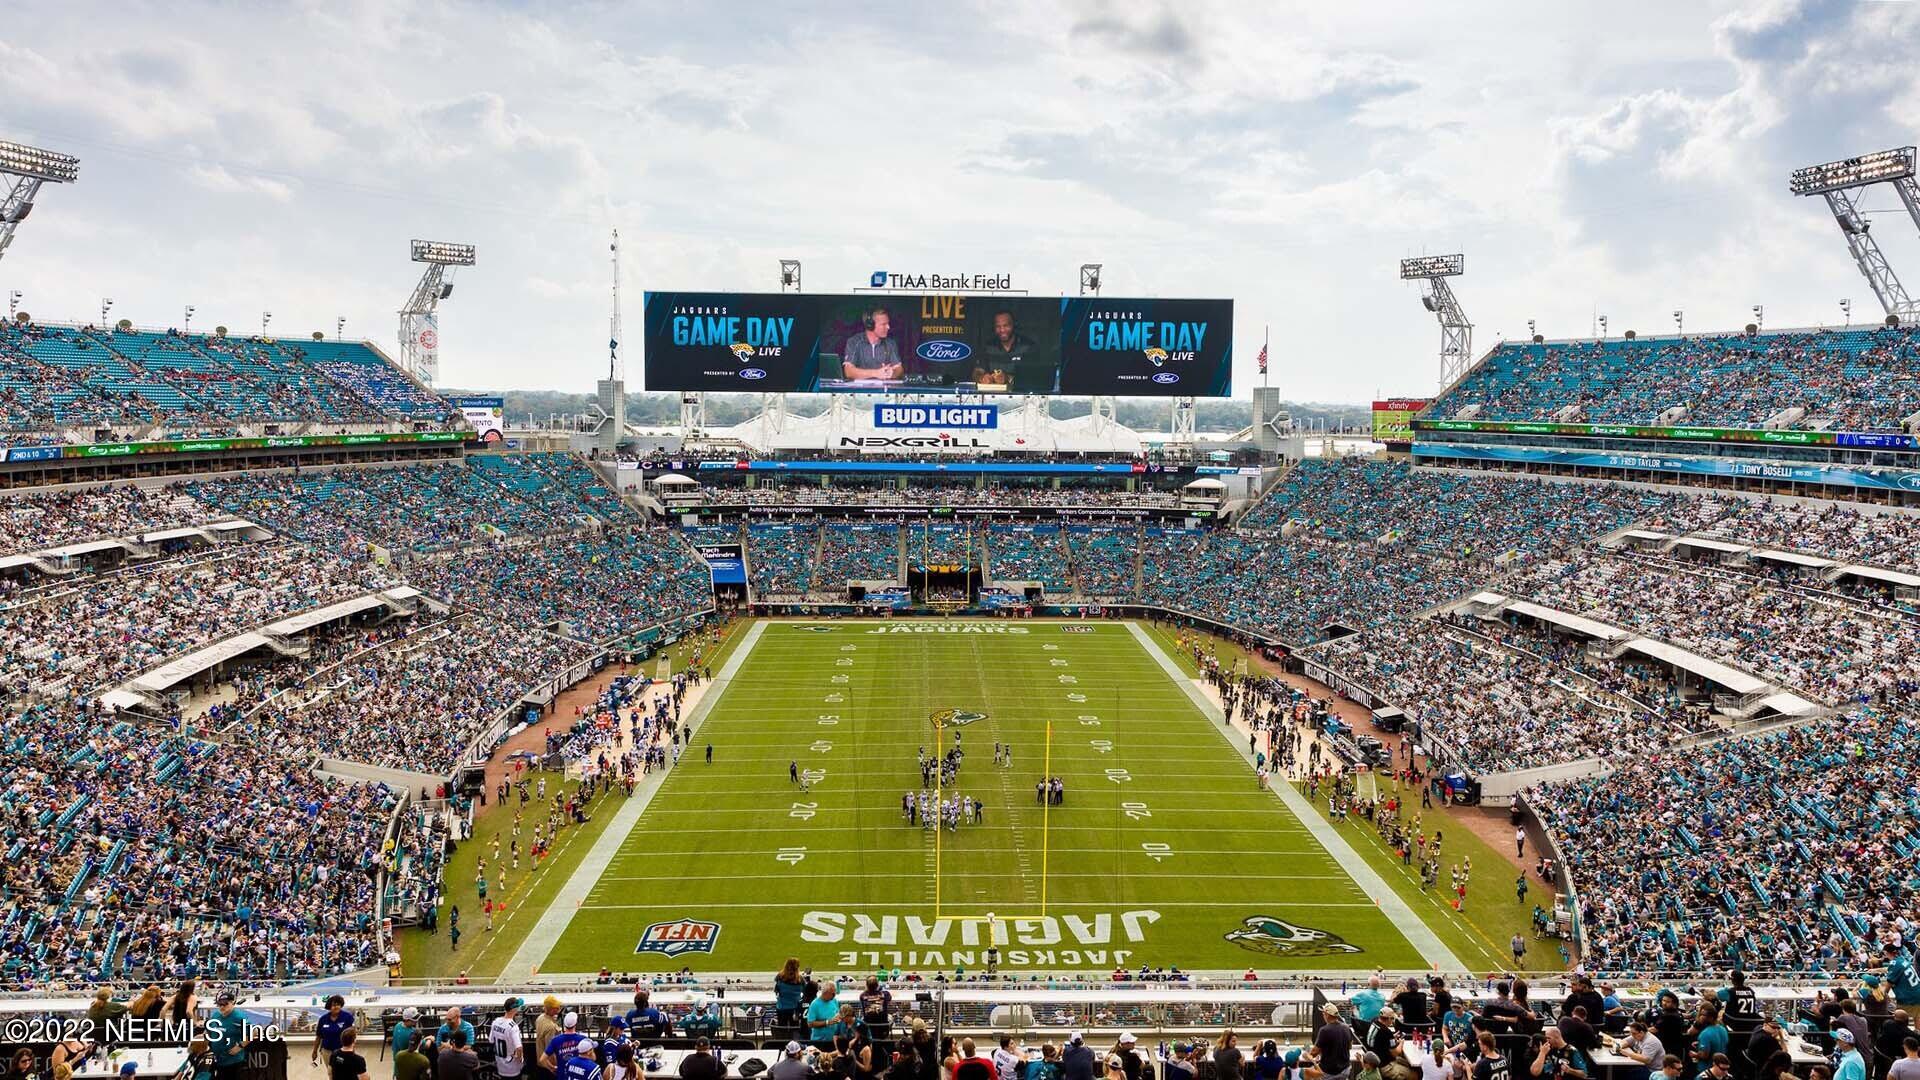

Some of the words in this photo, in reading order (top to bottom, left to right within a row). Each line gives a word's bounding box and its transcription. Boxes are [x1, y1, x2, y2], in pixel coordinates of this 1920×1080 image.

[889, 273, 928, 288] TIAA
[932, 273, 969, 289] Bank
[974, 273, 1011, 290] Field
[673, 306, 728, 315] JAGUARS
[921, 296, 966, 320] LIVE
[1089, 311, 1143, 320] JAGUARS
[673, 316, 741, 347] GAME
[746, 316, 795, 347] DAY
[922, 326, 953, 334] PRESENTED
[1089, 321, 1155, 351] GAME
[1160, 321, 1208, 351] DAY
[758, 347, 782, 357] LIVE
[926, 343, 961, 359] Ford
[1172, 351, 1195, 361] LIVE
[1388, 402, 1409, 410] xfinity
[881, 408, 928, 424] BUD
[929, 409, 991, 425] LIGHT
[13, 451, 27, 459] 2ND
[31, 450, 40, 459] 10
[1620, 457, 1637, 466] FRED
[1638, 458, 1661, 467] TAYLOR
[1740, 465, 1761, 475] TONY
[1763, 465, 1792, 477] BOSELLI
[865, 626, 1030, 634] JAGUARS
[1078, 715, 1101, 725] 50
[789, 802, 818, 818] 20
[1121, 802, 1152, 817] 20
[776, 846, 807, 861] 10
[1141, 843, 1174, 857] 10
[654, 923, 713, 940] NFL
[800, 909, 1161, 947] JAGUARS
[838, 950, 1133, 967] JACKSONVILLE
[1737, 997, 1755, 1014] 27
